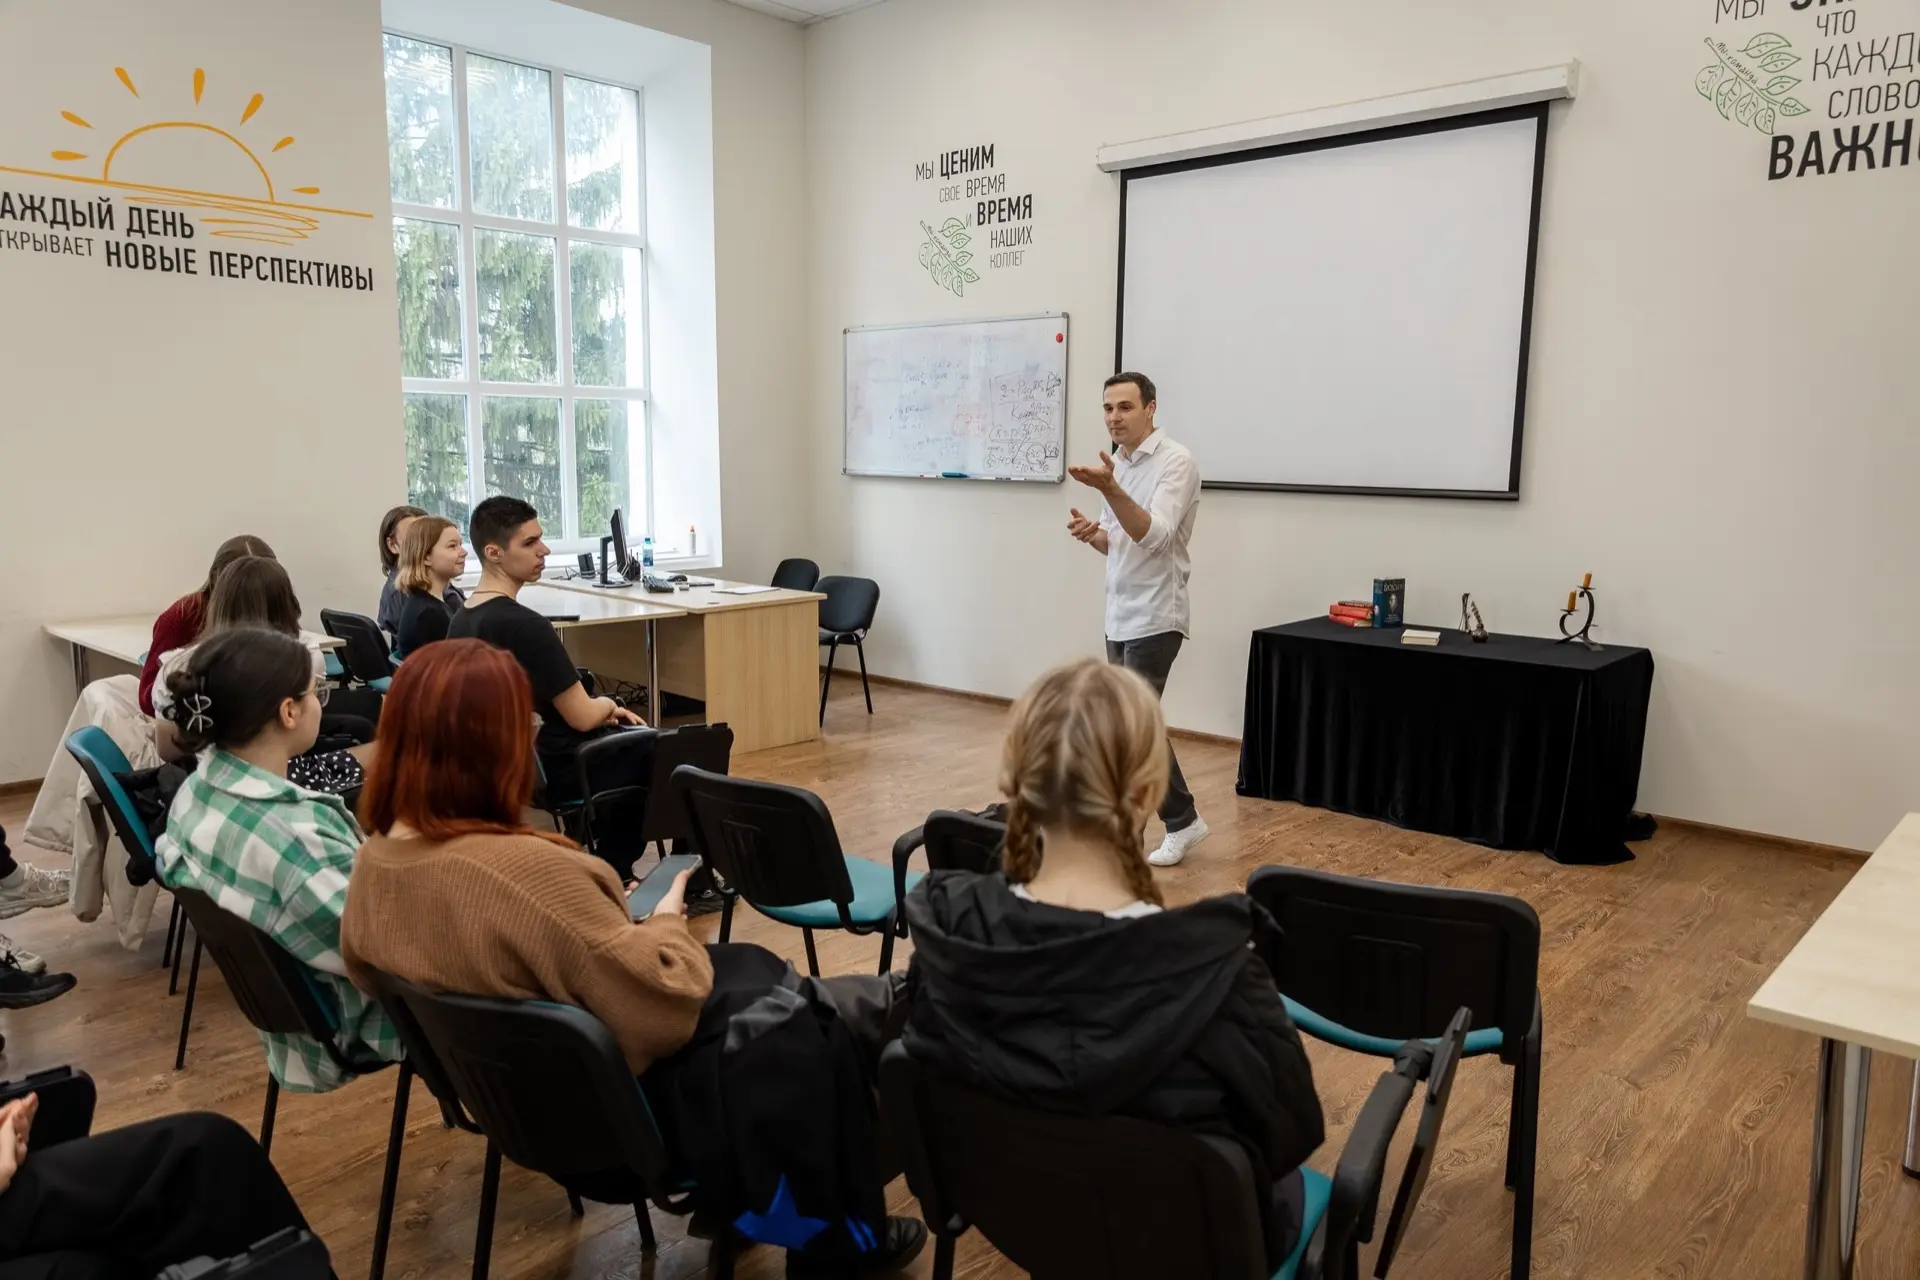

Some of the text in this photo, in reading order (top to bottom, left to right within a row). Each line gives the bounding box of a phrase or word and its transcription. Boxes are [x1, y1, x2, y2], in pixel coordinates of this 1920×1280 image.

[1715, 0, 1765, 24] МЫ
[1816, 9, 1856, 37] ЧТО
[1813, 32, 1920, 81] КАЖД
[1828, 79, 1920, 119] СЛОВО
[916, 143, 994, 181] МЫ ЦЕНИМ
[1768, 118, 1920, 181] ВАЖН
[939, 173, 1005, 203] СВОЕ ВРЕМЯ
[126, 206, 194, 239] ДЕНЬ
[977, 194, 1032, 226] ВРЕМЯ
[990, 225, 1033, 249] НАШИХ
[105, 240, 198, 275] НОВЫЕ
[209, 250, 374, 291] ПЕРСПЕКТИВЫ
[990, 250, 1025, 269] КОЛЛЕГ
